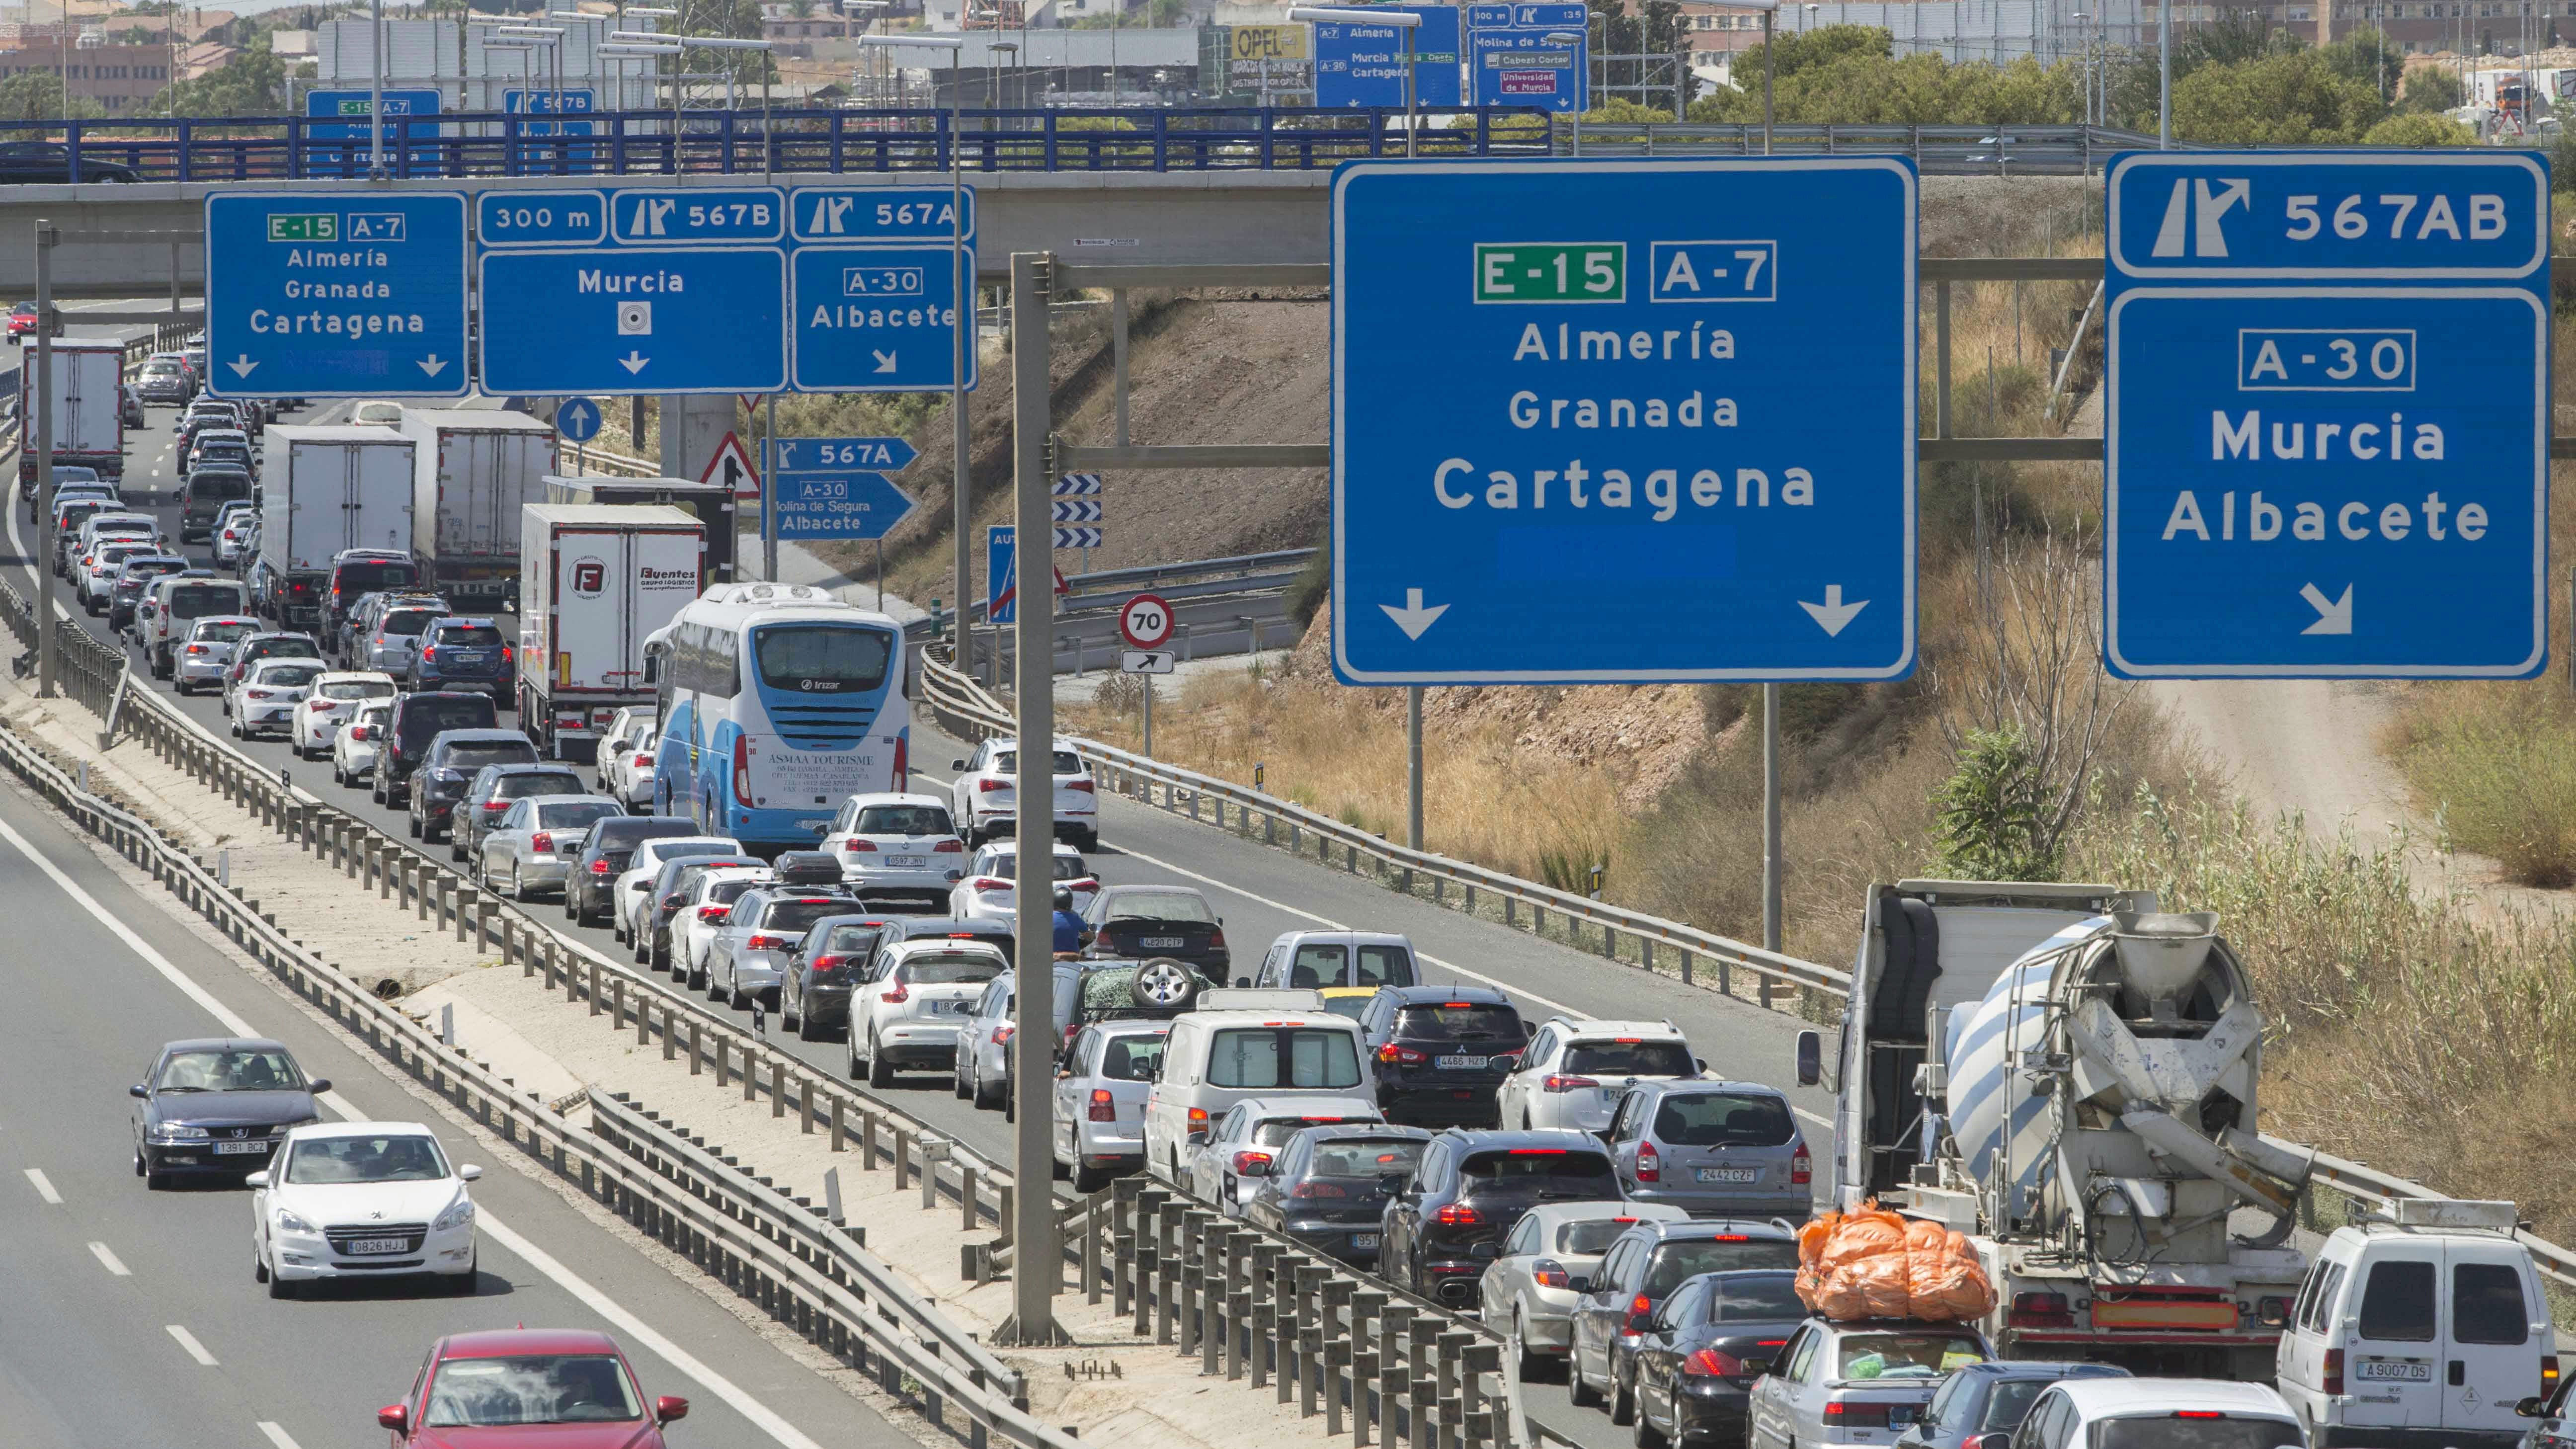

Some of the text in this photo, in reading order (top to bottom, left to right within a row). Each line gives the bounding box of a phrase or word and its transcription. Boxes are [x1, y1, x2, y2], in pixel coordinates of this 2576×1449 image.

[1237, 29, 1283, 57] OPEL
[1476, 37, 1513, 47] Molina
[1519, 37, 1534, 47] de
[1322, 61, 1345, 71] A-30
[1352, 53, 1389, 63] Murcia
[1503, 73, 1554, 81] Universidad
[340, 102, 372, 113] E-15
[382, 102, 406, 113] A-7
[495, 208, 590, 228] 300 m
[689, 204, 770, 226] 567B
[877, 203, 955, 225] 567A
[2285, 194, 2507, 241] 567AB
[272, 218, 333, 237] E-15
[353, 218, 400, 237] A-7
[287, 249, 387, 267] Almería
[1483, 251, 1617, 294] E-15
[1662, 250, 1768, 292] A-7
[285, 280, 390, 298] Granada
[578, 269, 684, 293] Murcia
[849, 272, 918, 292] A-30
[250, 309, 424, 340] Cartagena
[810, 304, 955, 328] Albacete
[1513, 321, 1736, 361] Almería
[2249, 338, 2406, 380] A-30
[1509, 391, 1738, 429] Granada
[2212, 410, 2445, 461] Murcia
[820, 444, 892, 464] 567A
[803, 483, 845, 497] A-30
[1434, 458, 1815, 522] Cartagena
[776, 500, 871, 514] olina de Segura
[2162, 490, 2489, 541] Albacete
[782, 515, 861, 530] Albacete
[641, 567, 695, 579] Fuentes
[1133, 613, 1161, 631] 70
[768, 754, 875, 766] ASMAA TOURISME
[1442, 1057, 1463, 1066] 4466
[221, 1143, 264, 1152] 1391 BCZ
[1702, 1170, 1752, 1180] 2442 CZF
[355, 1240, 405, 1252] 0826 HJJ
[1358, 1235, 1378, 1245] 951
[2367, 1364, 2374, 1376] A
[2376, 1365, 2407, 1376] 9007
